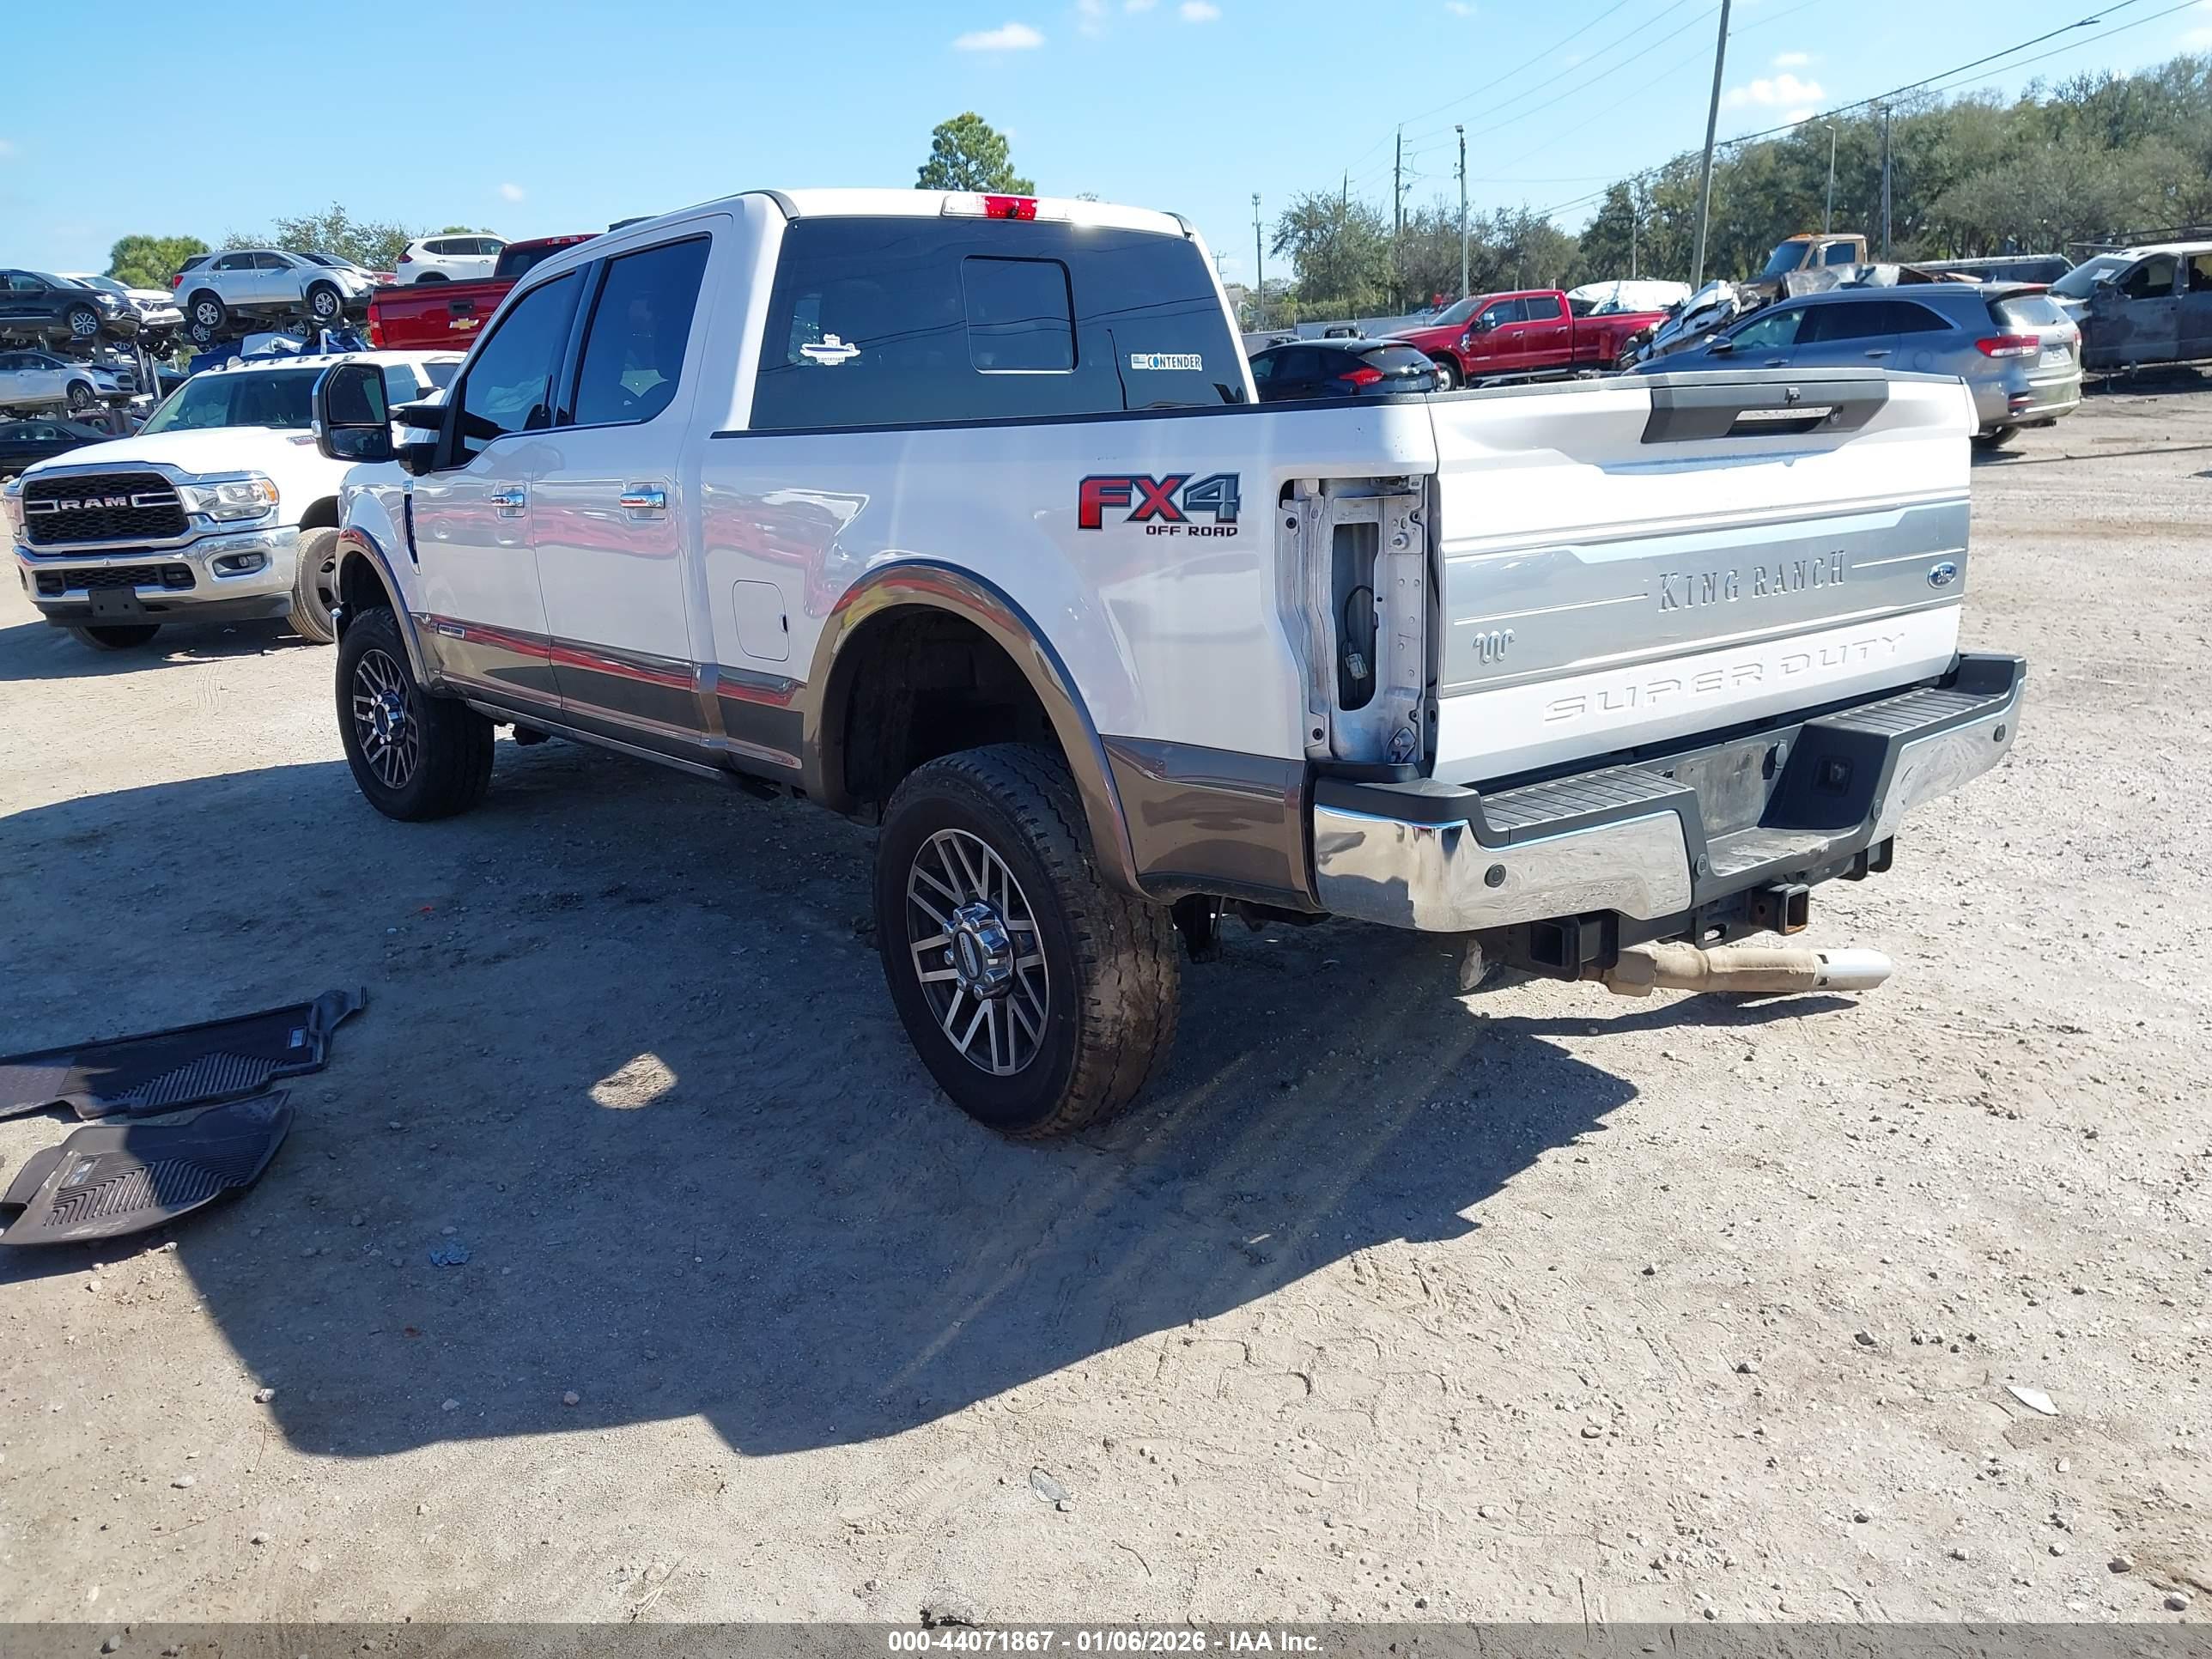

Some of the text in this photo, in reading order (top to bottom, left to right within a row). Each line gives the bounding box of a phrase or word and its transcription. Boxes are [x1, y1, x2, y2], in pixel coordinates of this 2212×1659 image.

[1147, 356, 1200, 368] CONTENDER
[60, 496, 128, 510] RAM
[1078, 472, 1242, 532] FX4
[1146, 525, 1238, 538] OFF ROAD
[1658, 550, 1846, 612] KING RANCH
[1544, 632, 1906, 724] SUPER DUTY
